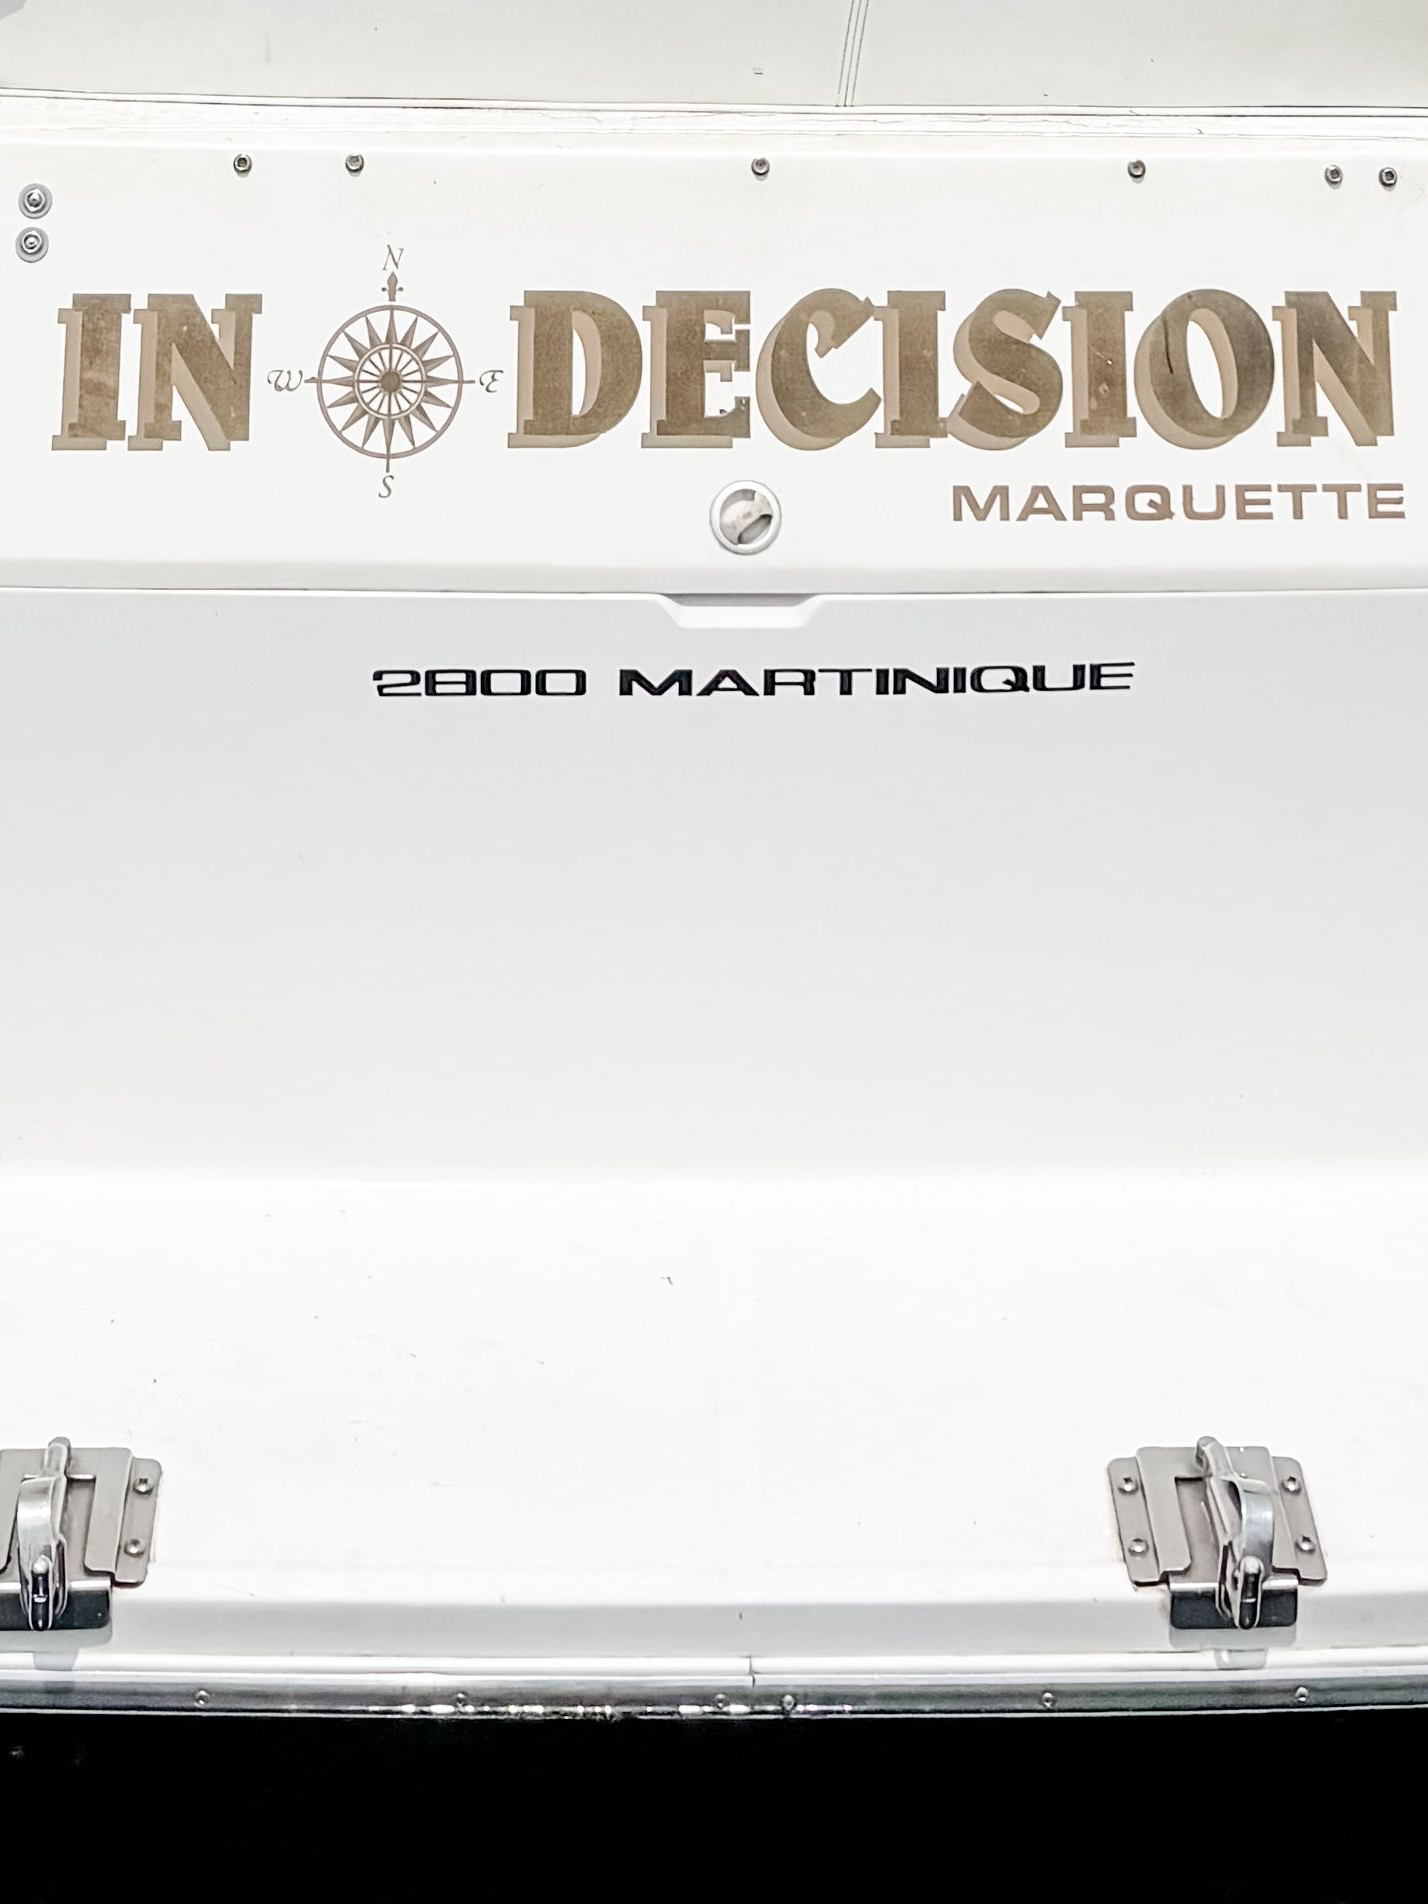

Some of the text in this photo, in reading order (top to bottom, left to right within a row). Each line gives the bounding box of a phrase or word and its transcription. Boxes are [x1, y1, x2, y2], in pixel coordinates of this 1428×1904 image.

[382, 244, 404, 271] N
[51, 288, 1399, 452] IN DECISION
[266, 369, 304, 392] W
[479, 369, 504, 393] E
[378, 474, 395, 499] S
[952, 482, 1407, 522] MARQUETTE
[372, 661, 1136, 698] 2800 MARTINIQUE
